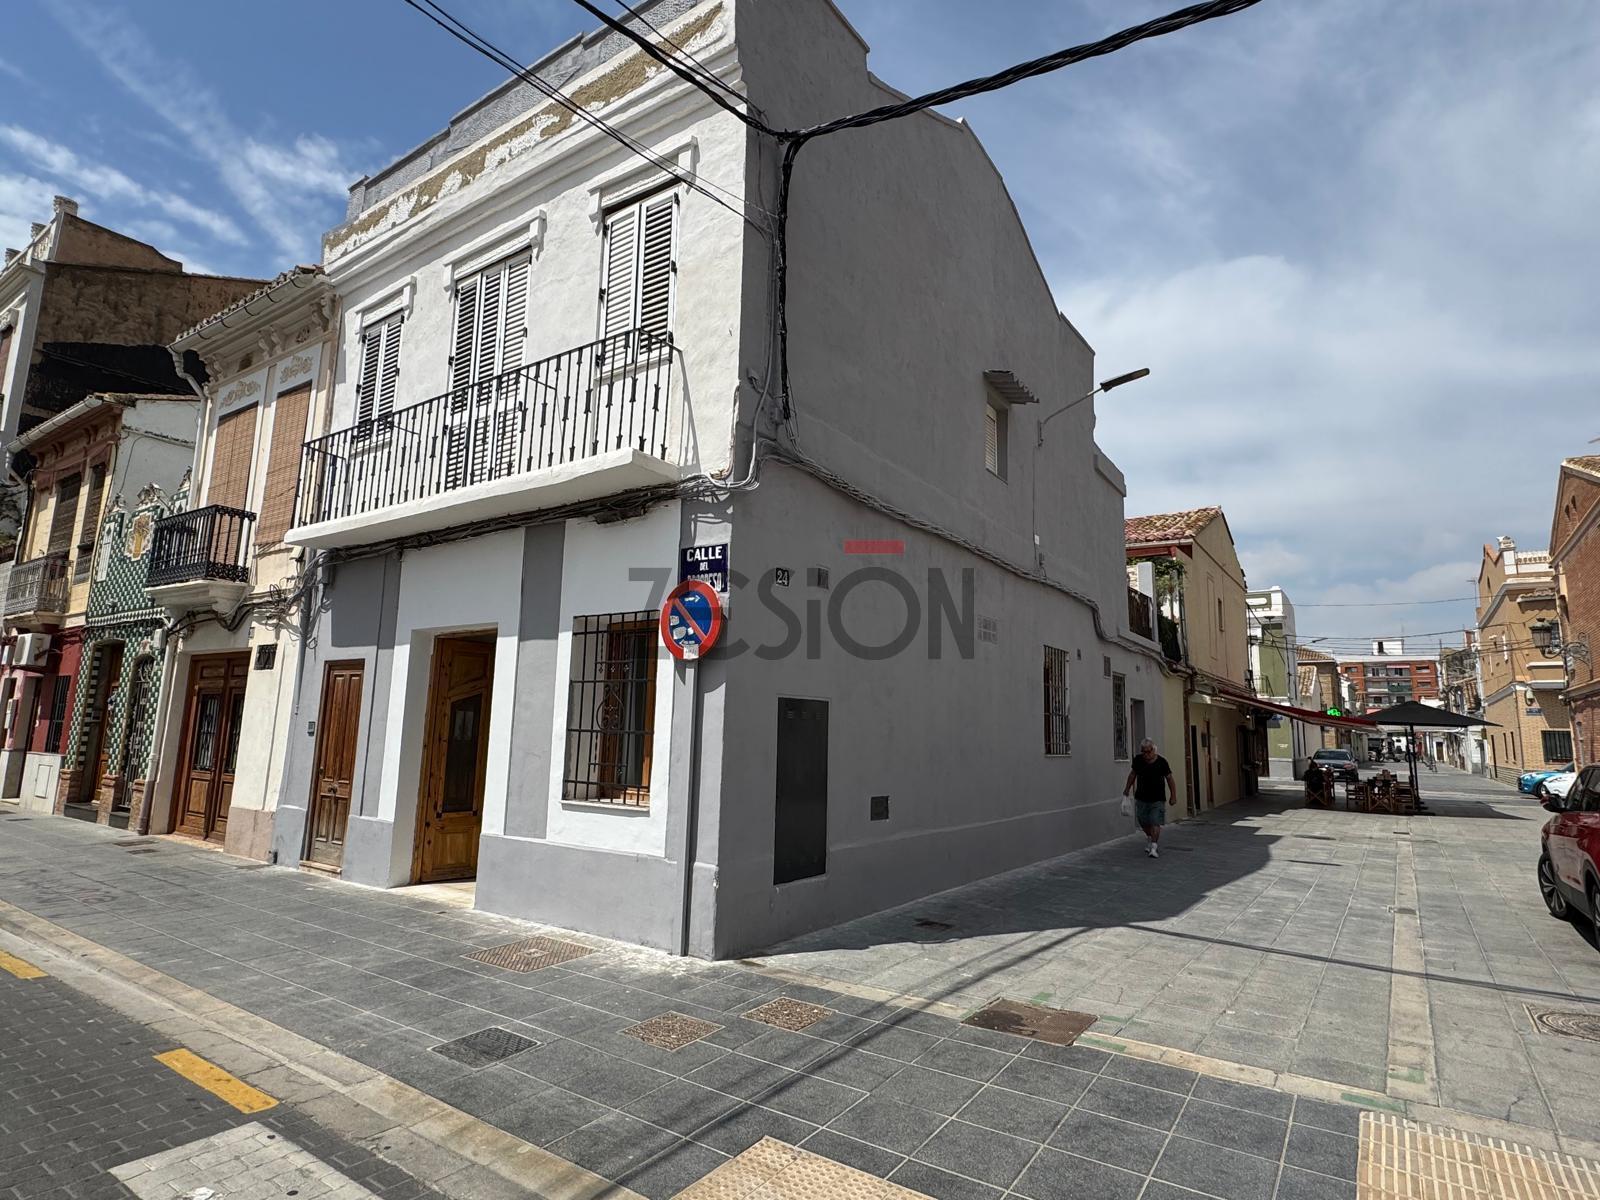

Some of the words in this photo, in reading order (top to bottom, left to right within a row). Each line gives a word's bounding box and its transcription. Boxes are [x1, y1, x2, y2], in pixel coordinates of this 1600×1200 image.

[687, 546, 723, 561] CALLE
[700, 561, 709, 571] DEL
[777, 570, 788, 586] 24
